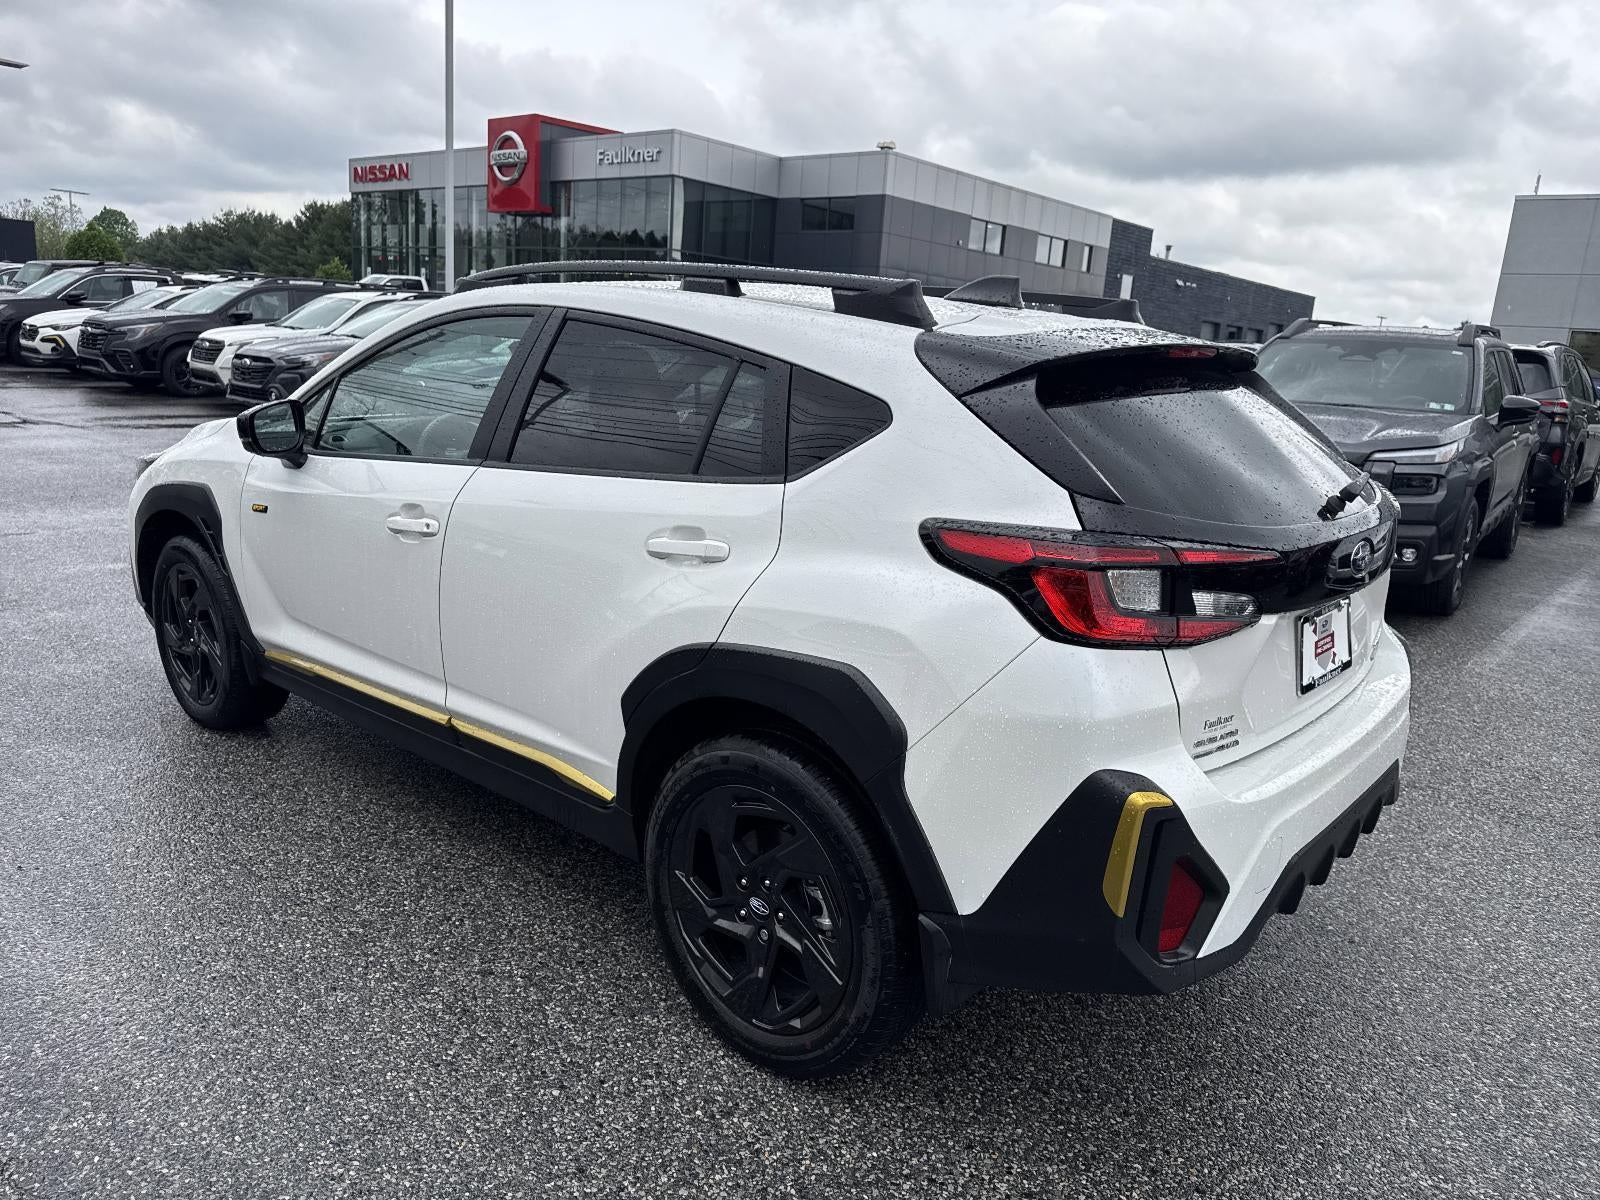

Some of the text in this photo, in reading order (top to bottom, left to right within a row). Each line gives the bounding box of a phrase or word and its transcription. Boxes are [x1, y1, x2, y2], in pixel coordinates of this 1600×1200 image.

[493, 151, 522, 162] NISSAN
[596, 146, 661, 166] Faulkner
[353, 162, 410, 184] NISSAN
[1314, 667, 1342, 688] Faulkner
[1203, 714, 1235, 731] Faulkner
